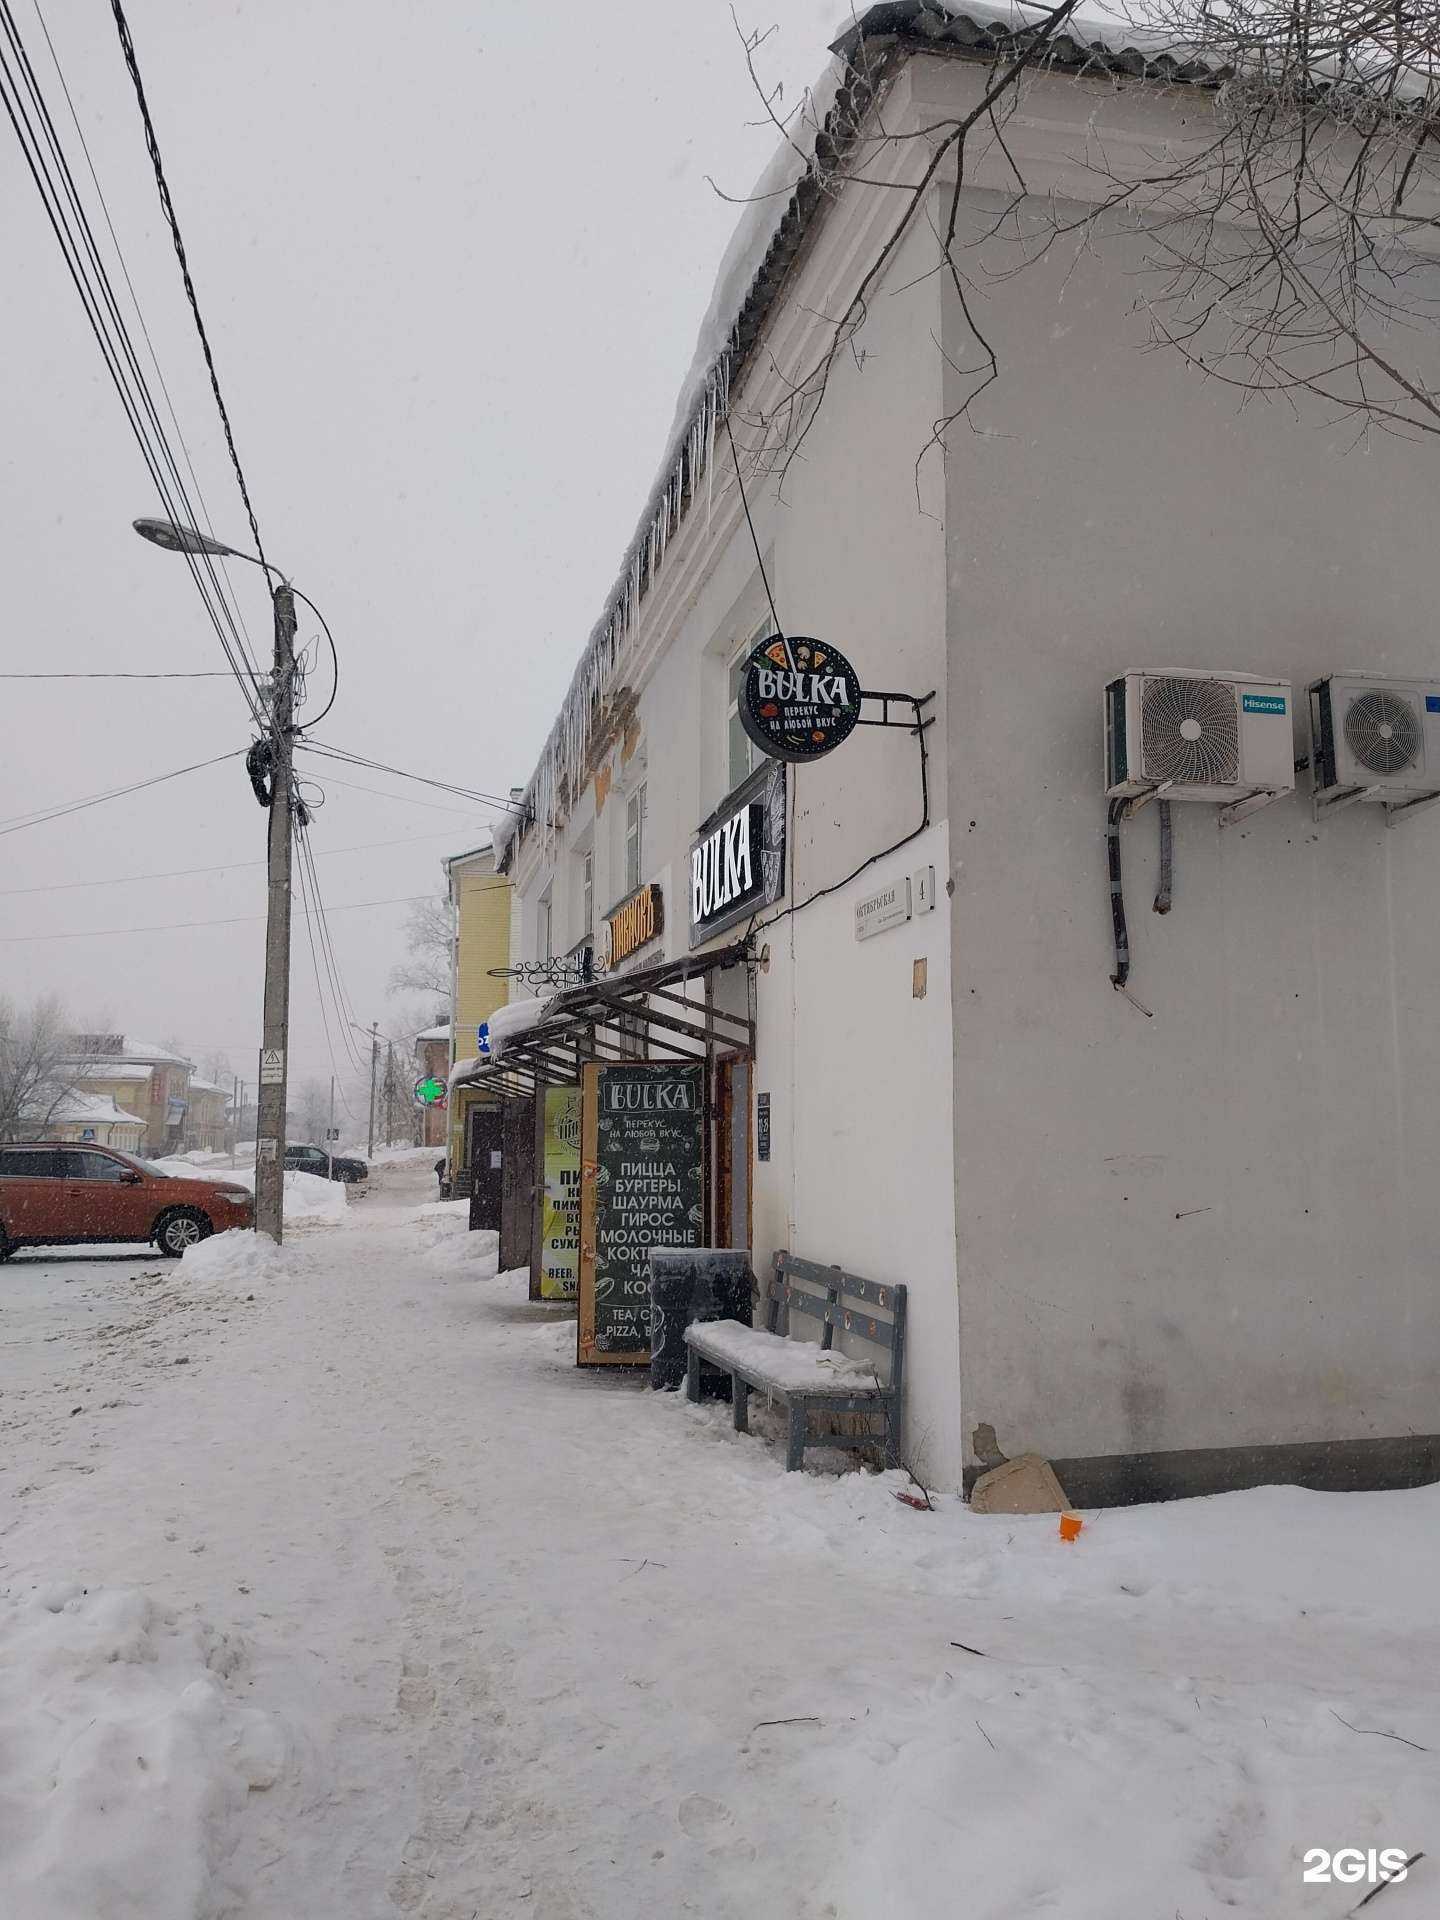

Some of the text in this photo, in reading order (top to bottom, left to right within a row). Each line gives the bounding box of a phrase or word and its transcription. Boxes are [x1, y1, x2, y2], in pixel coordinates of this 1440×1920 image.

[758, 669, 849, 706] BULKA
[784, 706, 819, 717] ПЕРЕКУС
[1244, 699, 1285, 710] Hisense
[784, 717, 812, 730] ЛЮБОЙ
[815, 718, 836, 728] ВКУС
[692, 804, 753, 924] BULKA
[919, 879, 926, 901] 4
[611, 1084, 690, 1109] BULKA
[625, 1119, 667, 1129] ПЕРЕКУС
[660, 1129, 683, 1138] ВКУС
[621, 1162, 676, 1178] ПИЦЦА
[615, 1179, 681, 1193] БУРГЕРЫ
[612, 1196, 684, 1210] ШАУРМА
[621, 1212, 674, 1226] ГИРОС
[600, 1229, 695, 1244] МОЛОЧНЫЕ
[607, 1246, 650, 1260] КОКТ
[613, 1309, 637, 1321] TEA,
[606, 1326, 640, 1338] PIZZA,
